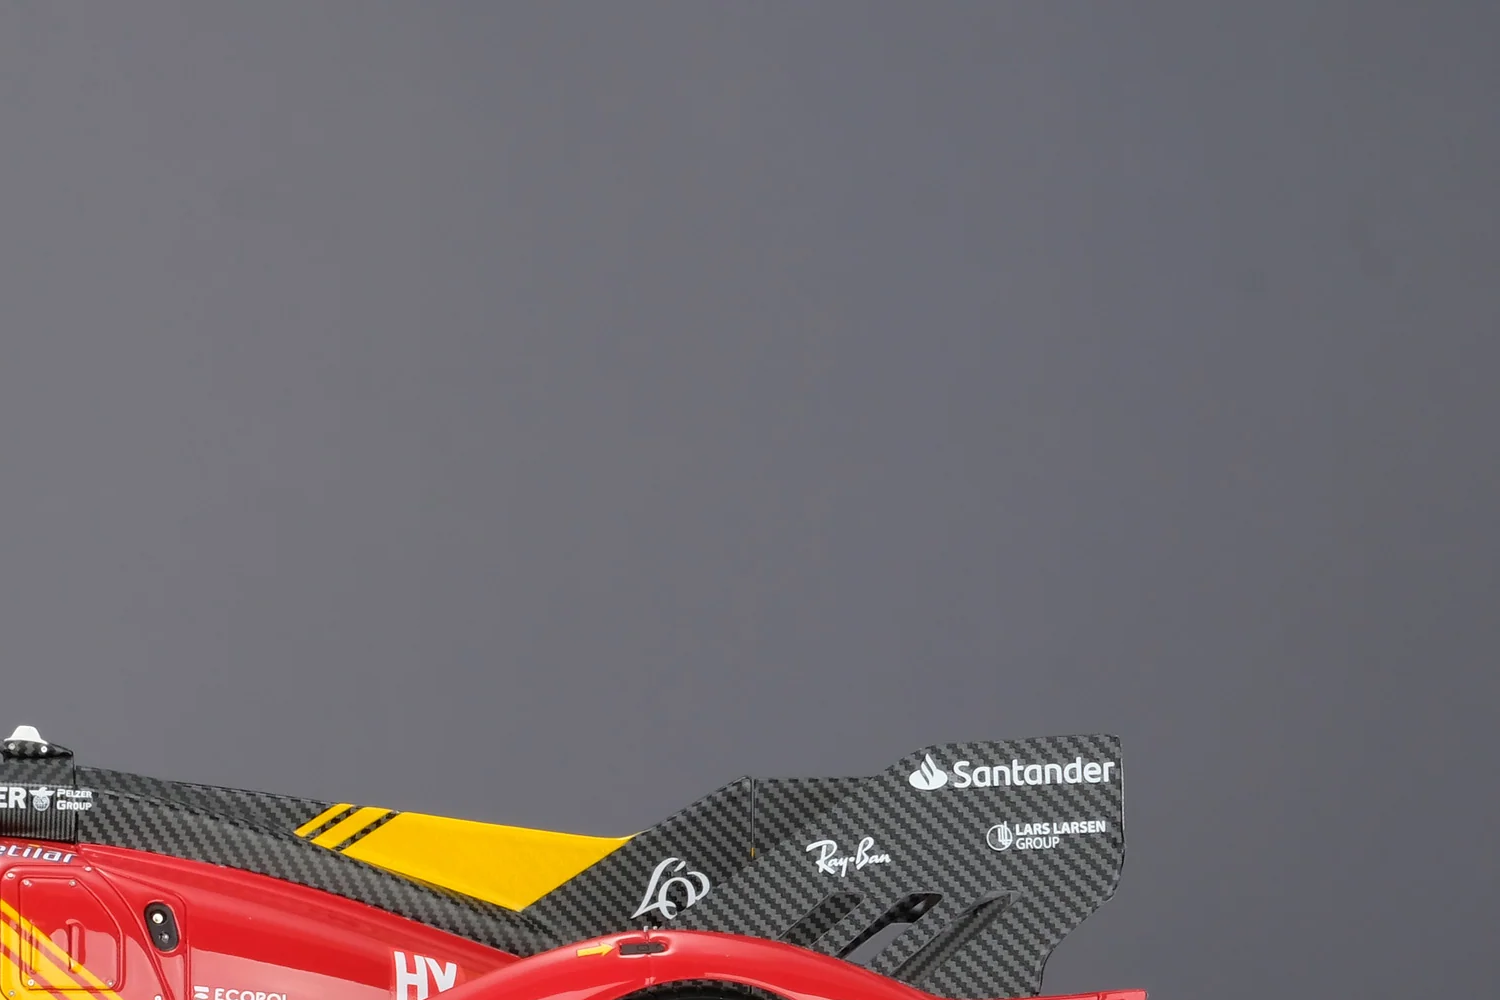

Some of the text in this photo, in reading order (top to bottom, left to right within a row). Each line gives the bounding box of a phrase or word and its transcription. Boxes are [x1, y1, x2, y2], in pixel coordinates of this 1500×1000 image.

[953, 756, 1115, 788] Santander
[56, 788, 93, 798] PELZER
[56, 800, 93, 811] GROUP
[1015, 820, 1106, 836] LARS LARSEN
[1016, 836, 1060, 850] GROUP
